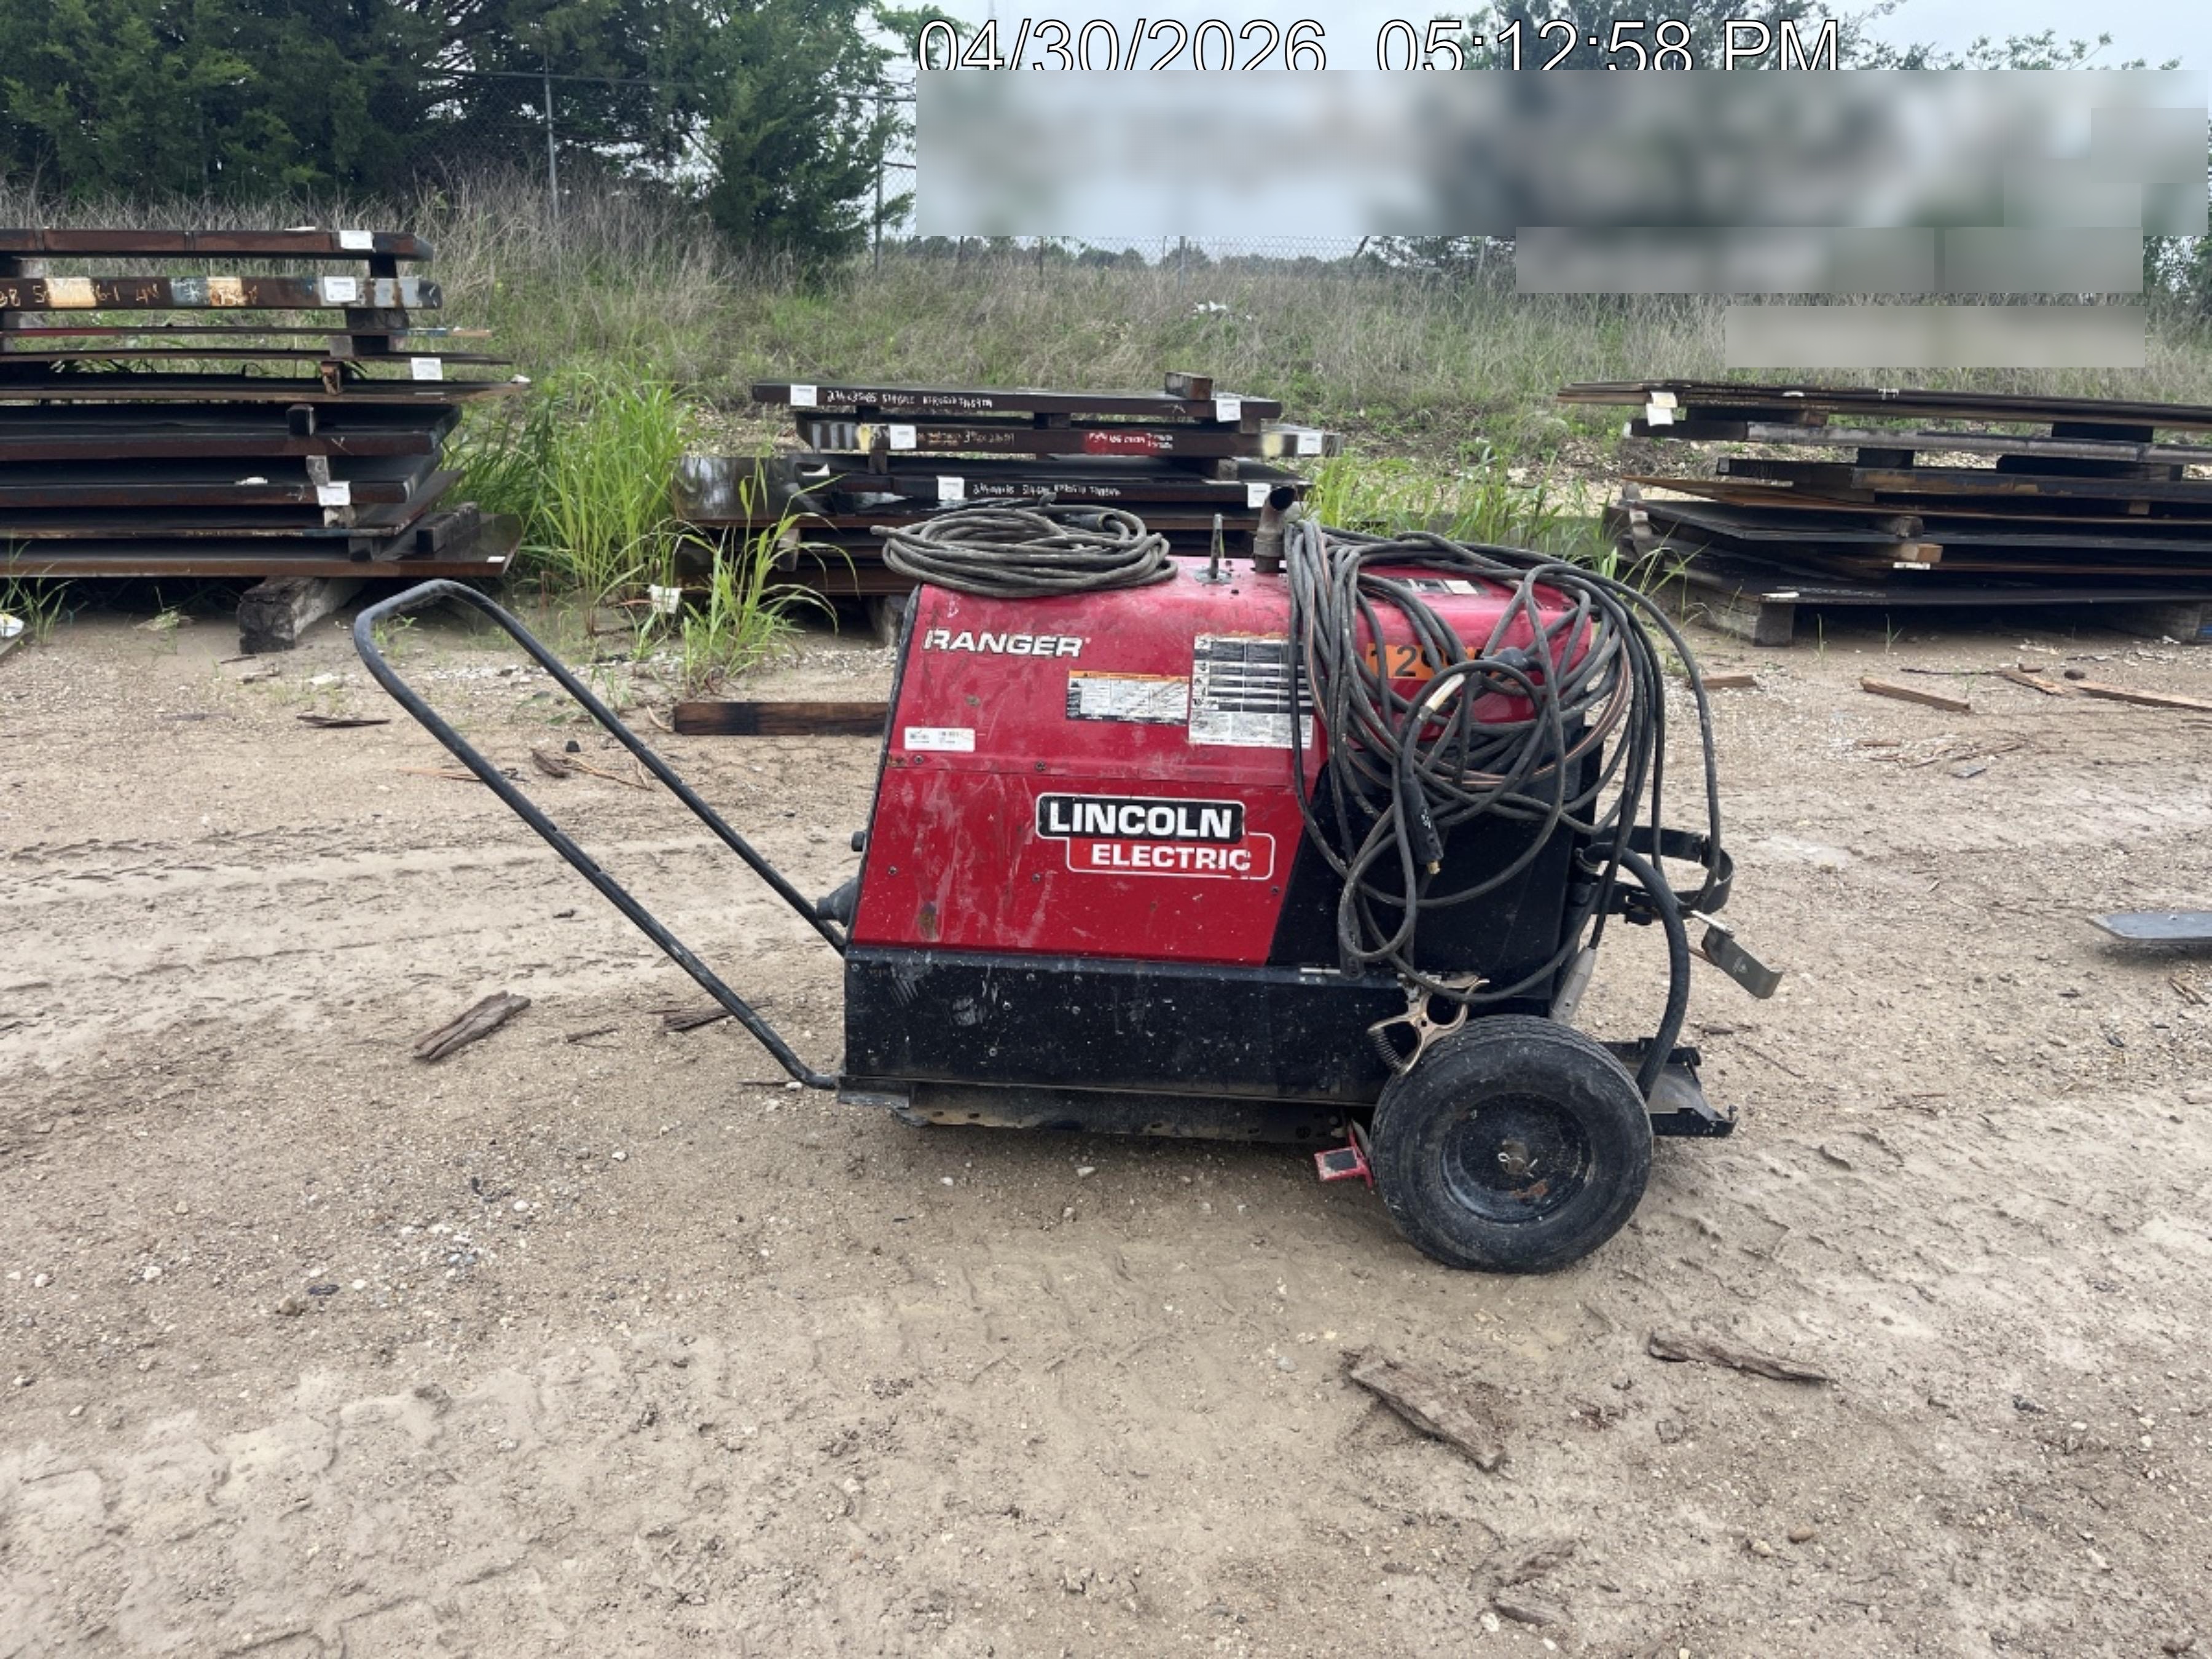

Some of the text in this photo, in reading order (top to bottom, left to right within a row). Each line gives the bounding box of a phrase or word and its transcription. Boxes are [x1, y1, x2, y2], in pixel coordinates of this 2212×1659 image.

[923, 628, 1083, 657] RANGER
[1049, 801, 1233, 838] LINCOLN
[1091, 843, 1252, 871] ELECTRIC
